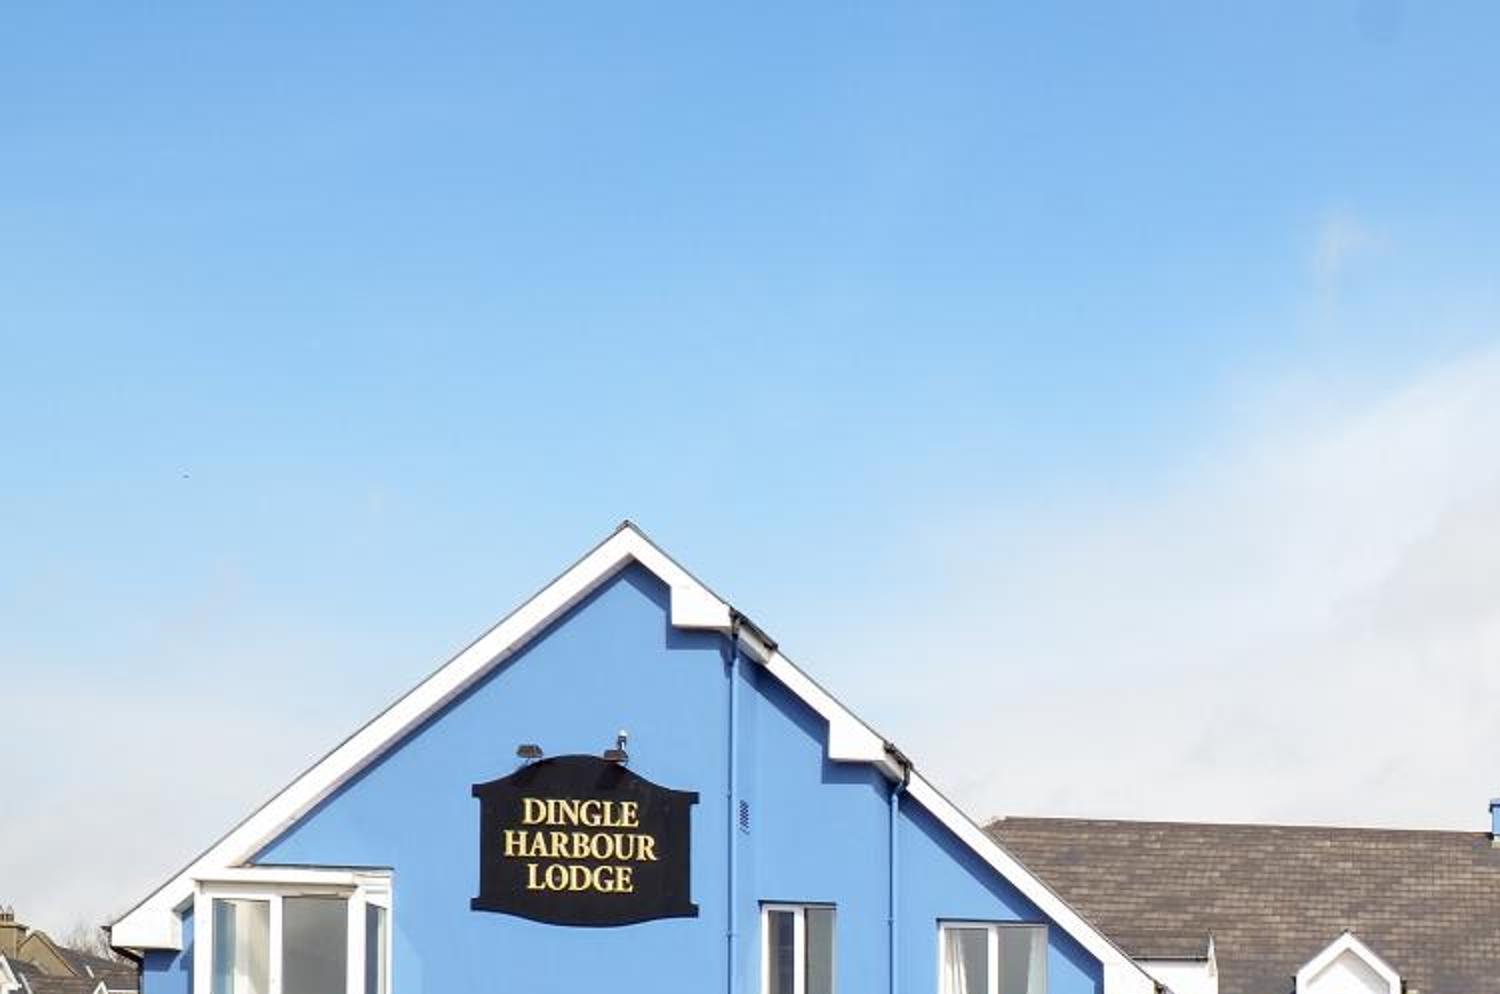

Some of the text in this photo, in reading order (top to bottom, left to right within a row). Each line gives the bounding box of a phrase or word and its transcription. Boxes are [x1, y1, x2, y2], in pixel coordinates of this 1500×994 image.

[522, 798, 640, 828] DINGLE
[504, 830, 658, 861] HARBOUR
[527, 863, 634, 893] LODGE
